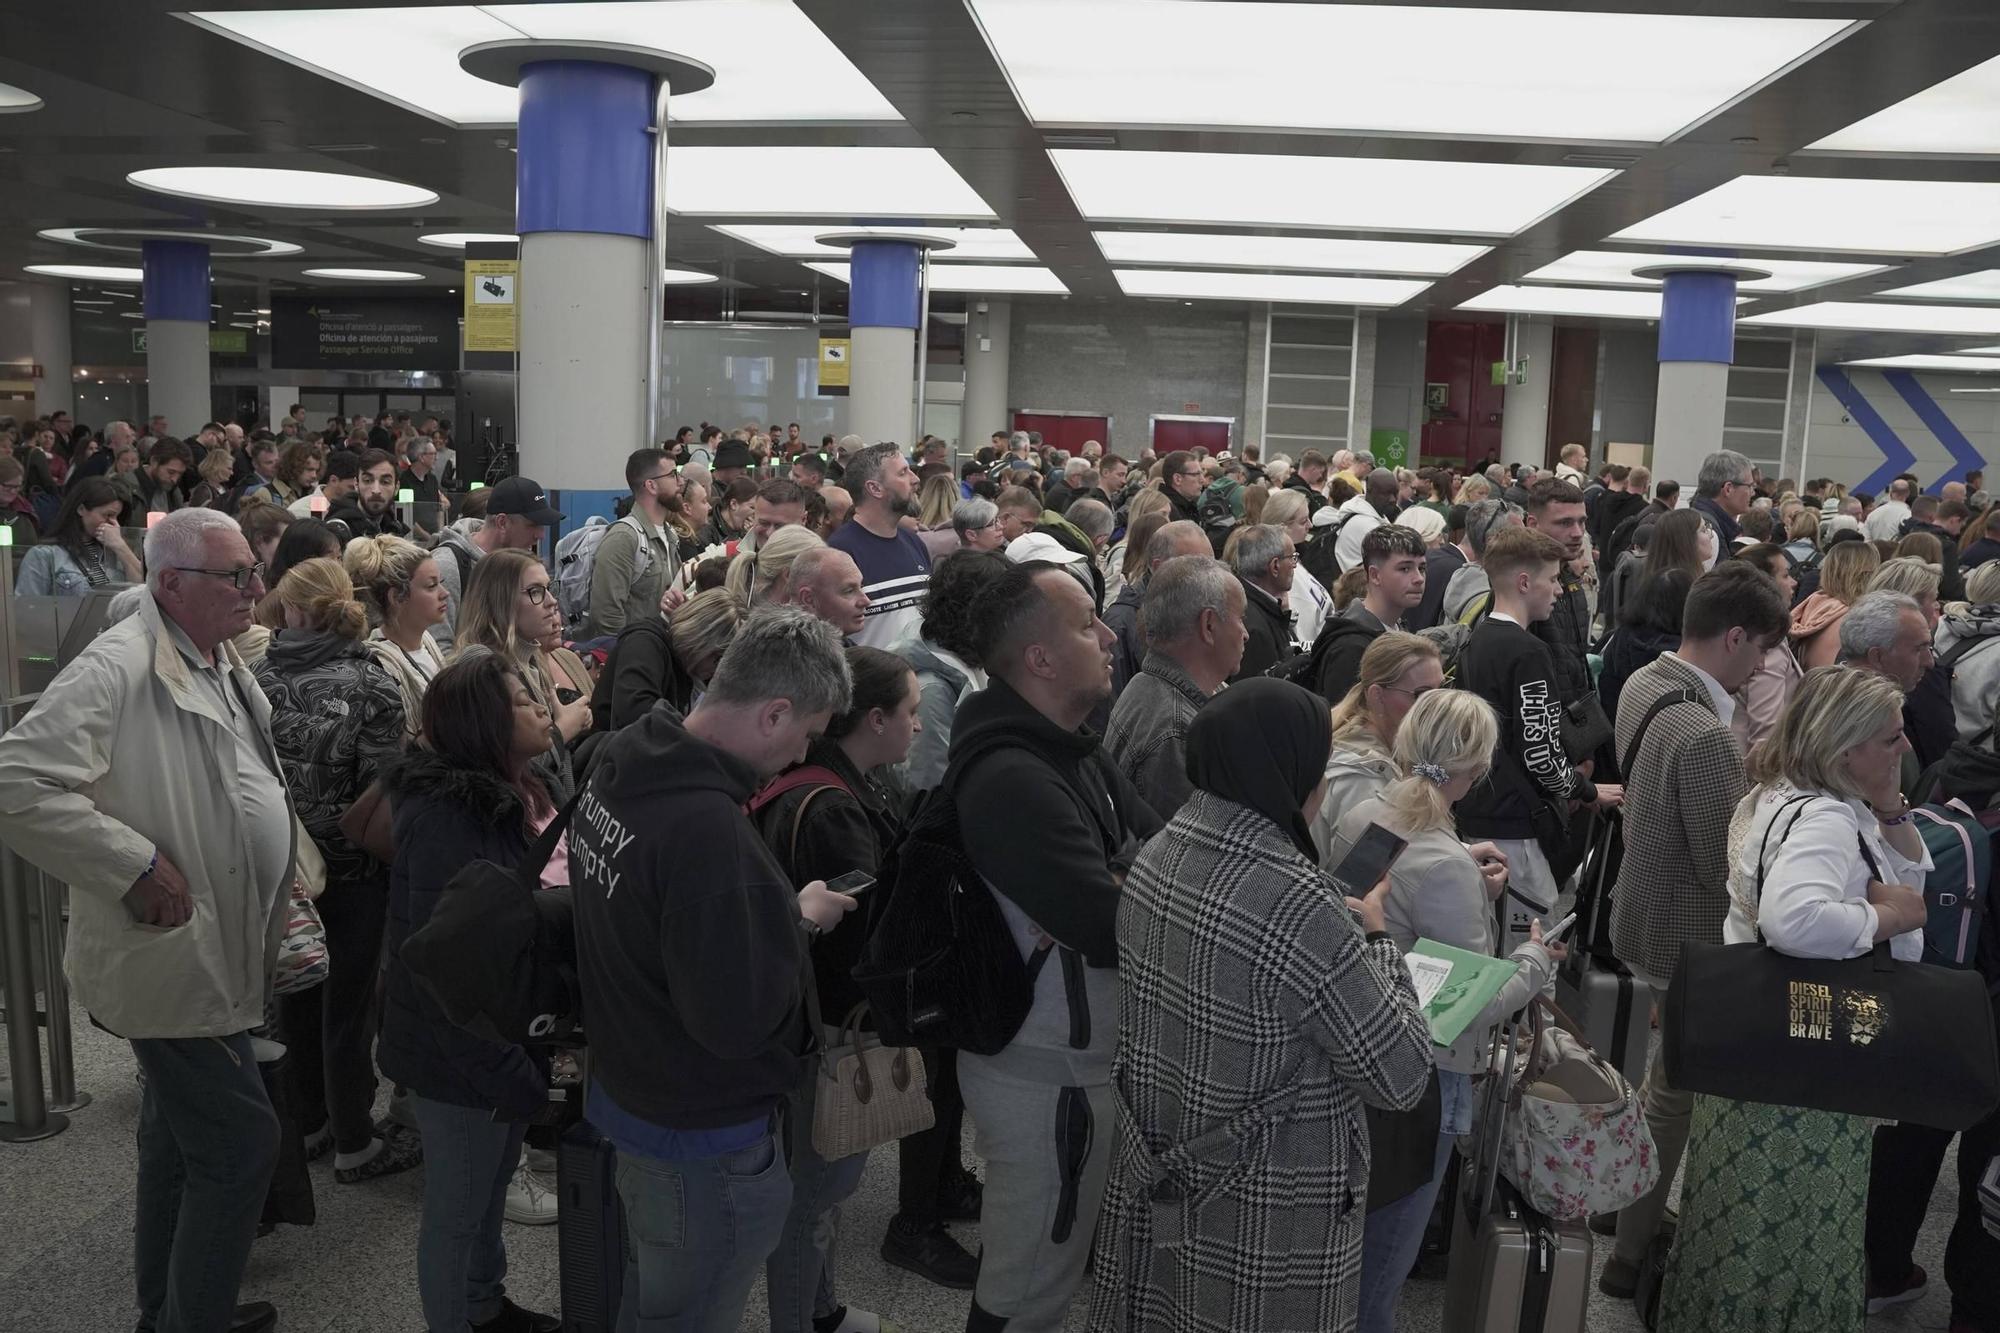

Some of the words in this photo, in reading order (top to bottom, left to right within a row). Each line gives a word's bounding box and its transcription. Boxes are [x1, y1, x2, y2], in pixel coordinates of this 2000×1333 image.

[319, 323, 343, 331] Oficina
[319, 334, 346, 343] Oficina
[347, 334, 357, 343] de
[359, 334, 392, 343] atención
[400, 335, 438, 345] pasajeros
[319, 345, 359, 355] Passenger
[361, 345, 389, 354] Service
[390, 345, 414, 354] Office
[1520, 679, 1548, 742] WHAT'S
[1524, 743, 1554, 774] UP
[571, 818, 621, 899] umpty
[1790, 981, 1832, 998] DIESEL
[1790, 995, 1832, 1011] SPIRIT
[1790, 1008, 1806, 1023] OF
[1809, 1010, 1832, 1026] THE
[1789, 1023, 1832, 1041] BRAVE
